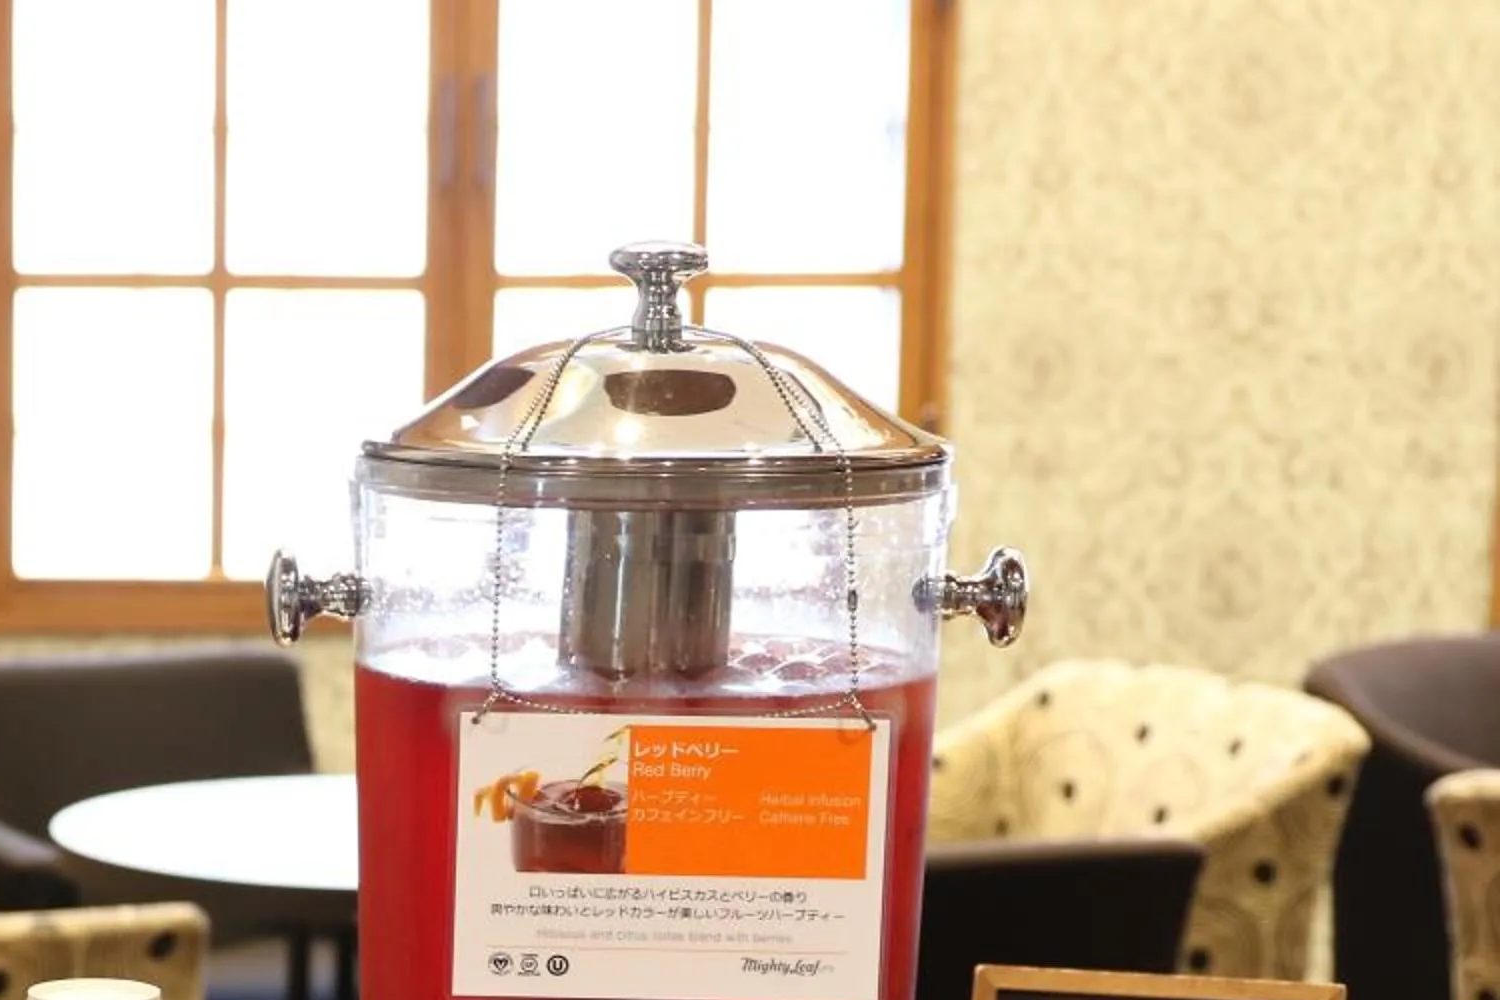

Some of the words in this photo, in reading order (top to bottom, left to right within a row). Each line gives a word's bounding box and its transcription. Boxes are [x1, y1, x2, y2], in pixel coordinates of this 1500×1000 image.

[634, 740, 740, 759] レッドベリー
[632, 762, 665, 777] Red
[670, 763, 712, 780] Berry
[759, 791, 805, 805] Herbal
[758, 810, 817, 825] Caffeine
[820, 812, 850, 825] Free
[740, 956, 790, 976] Mighty
[790, 958, 821, 976] Leaf
